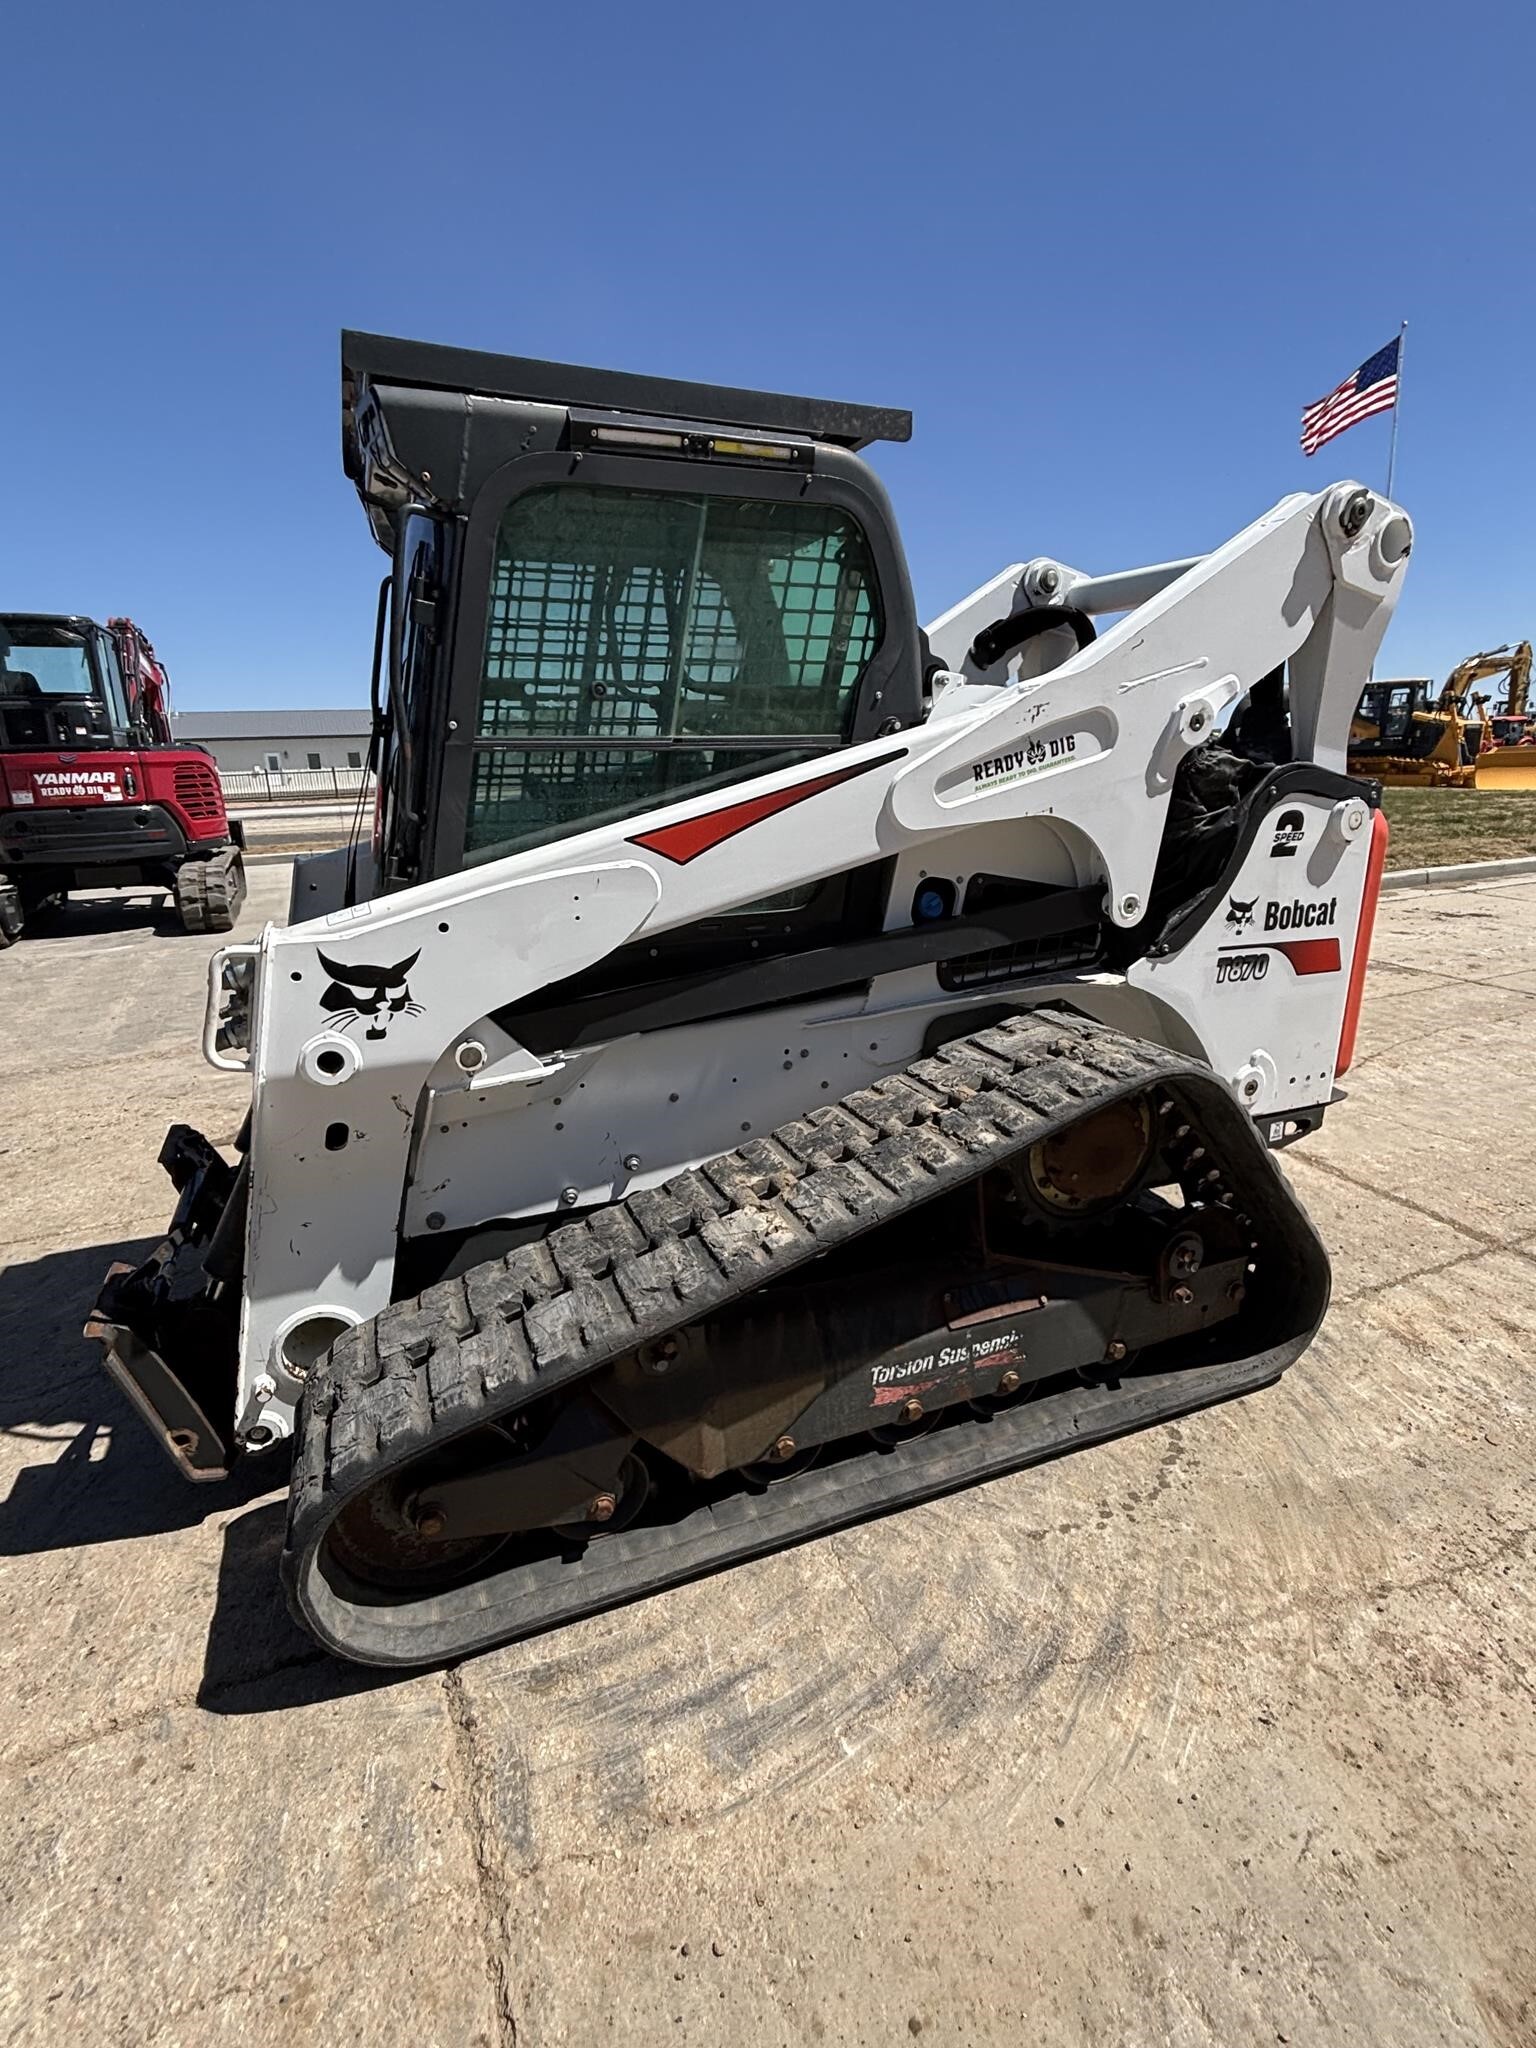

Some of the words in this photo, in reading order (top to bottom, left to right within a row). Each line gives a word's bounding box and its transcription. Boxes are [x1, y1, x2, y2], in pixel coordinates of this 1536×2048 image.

[972, 750, 1024, 782] READY
[1049, 735, 1075, 758] DIG
[33, 772, 116, 785] YANMAR
[40, 786, 72, 796] READY
[86, 785, 104, 795] DIG
[974, 779, 998, 792] ALWAYS
[998, 773, 1017, 785] READY
[1018, 770, 1026, 778] TO
[1269, 809, 1305, 858] 2
[1273, 832, 1305, 843] SPEED
[1263, 897, 1337, 931] Bobcat
[1216, 953, 1270, 984] T870
[871, 1354, 934, 1386] Torsion
